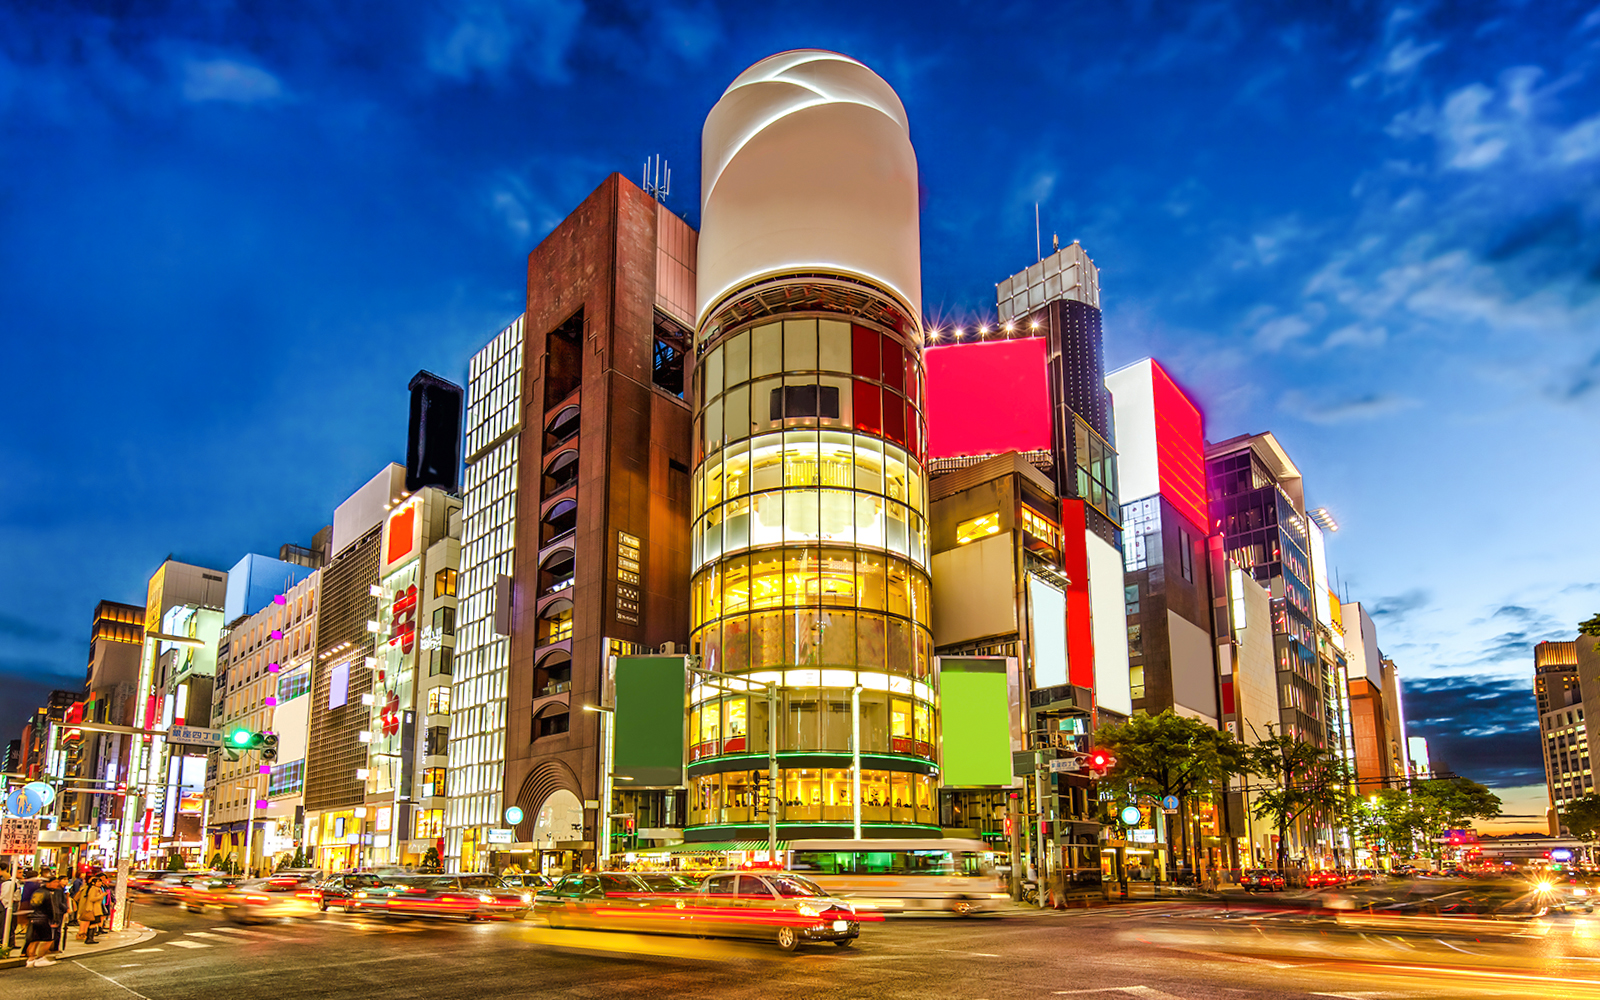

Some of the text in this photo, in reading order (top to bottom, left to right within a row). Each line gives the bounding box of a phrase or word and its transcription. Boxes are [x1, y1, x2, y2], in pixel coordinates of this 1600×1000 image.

[173, 730, 221, 741] 銀座四丁目
